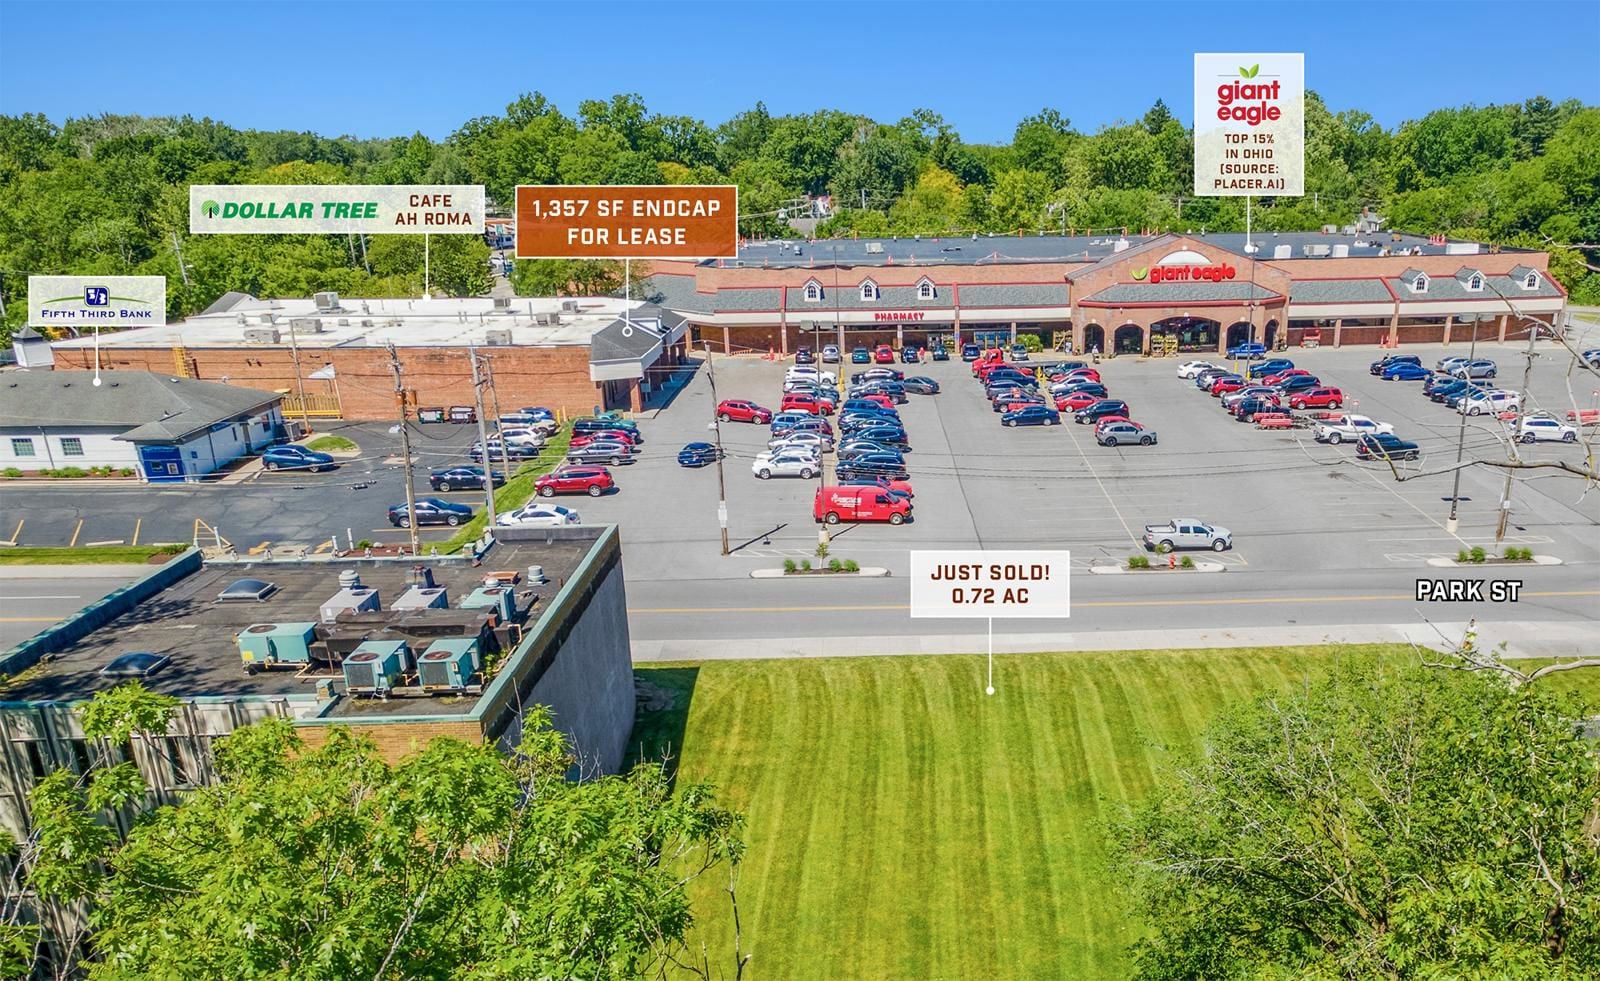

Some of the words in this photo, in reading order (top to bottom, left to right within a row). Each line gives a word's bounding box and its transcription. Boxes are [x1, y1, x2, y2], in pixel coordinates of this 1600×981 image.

[1150, 265, 1190, 283] giant
[1191, 262, 1236, 282] eagle
[874, 312, 925, 321] PHARMACY
